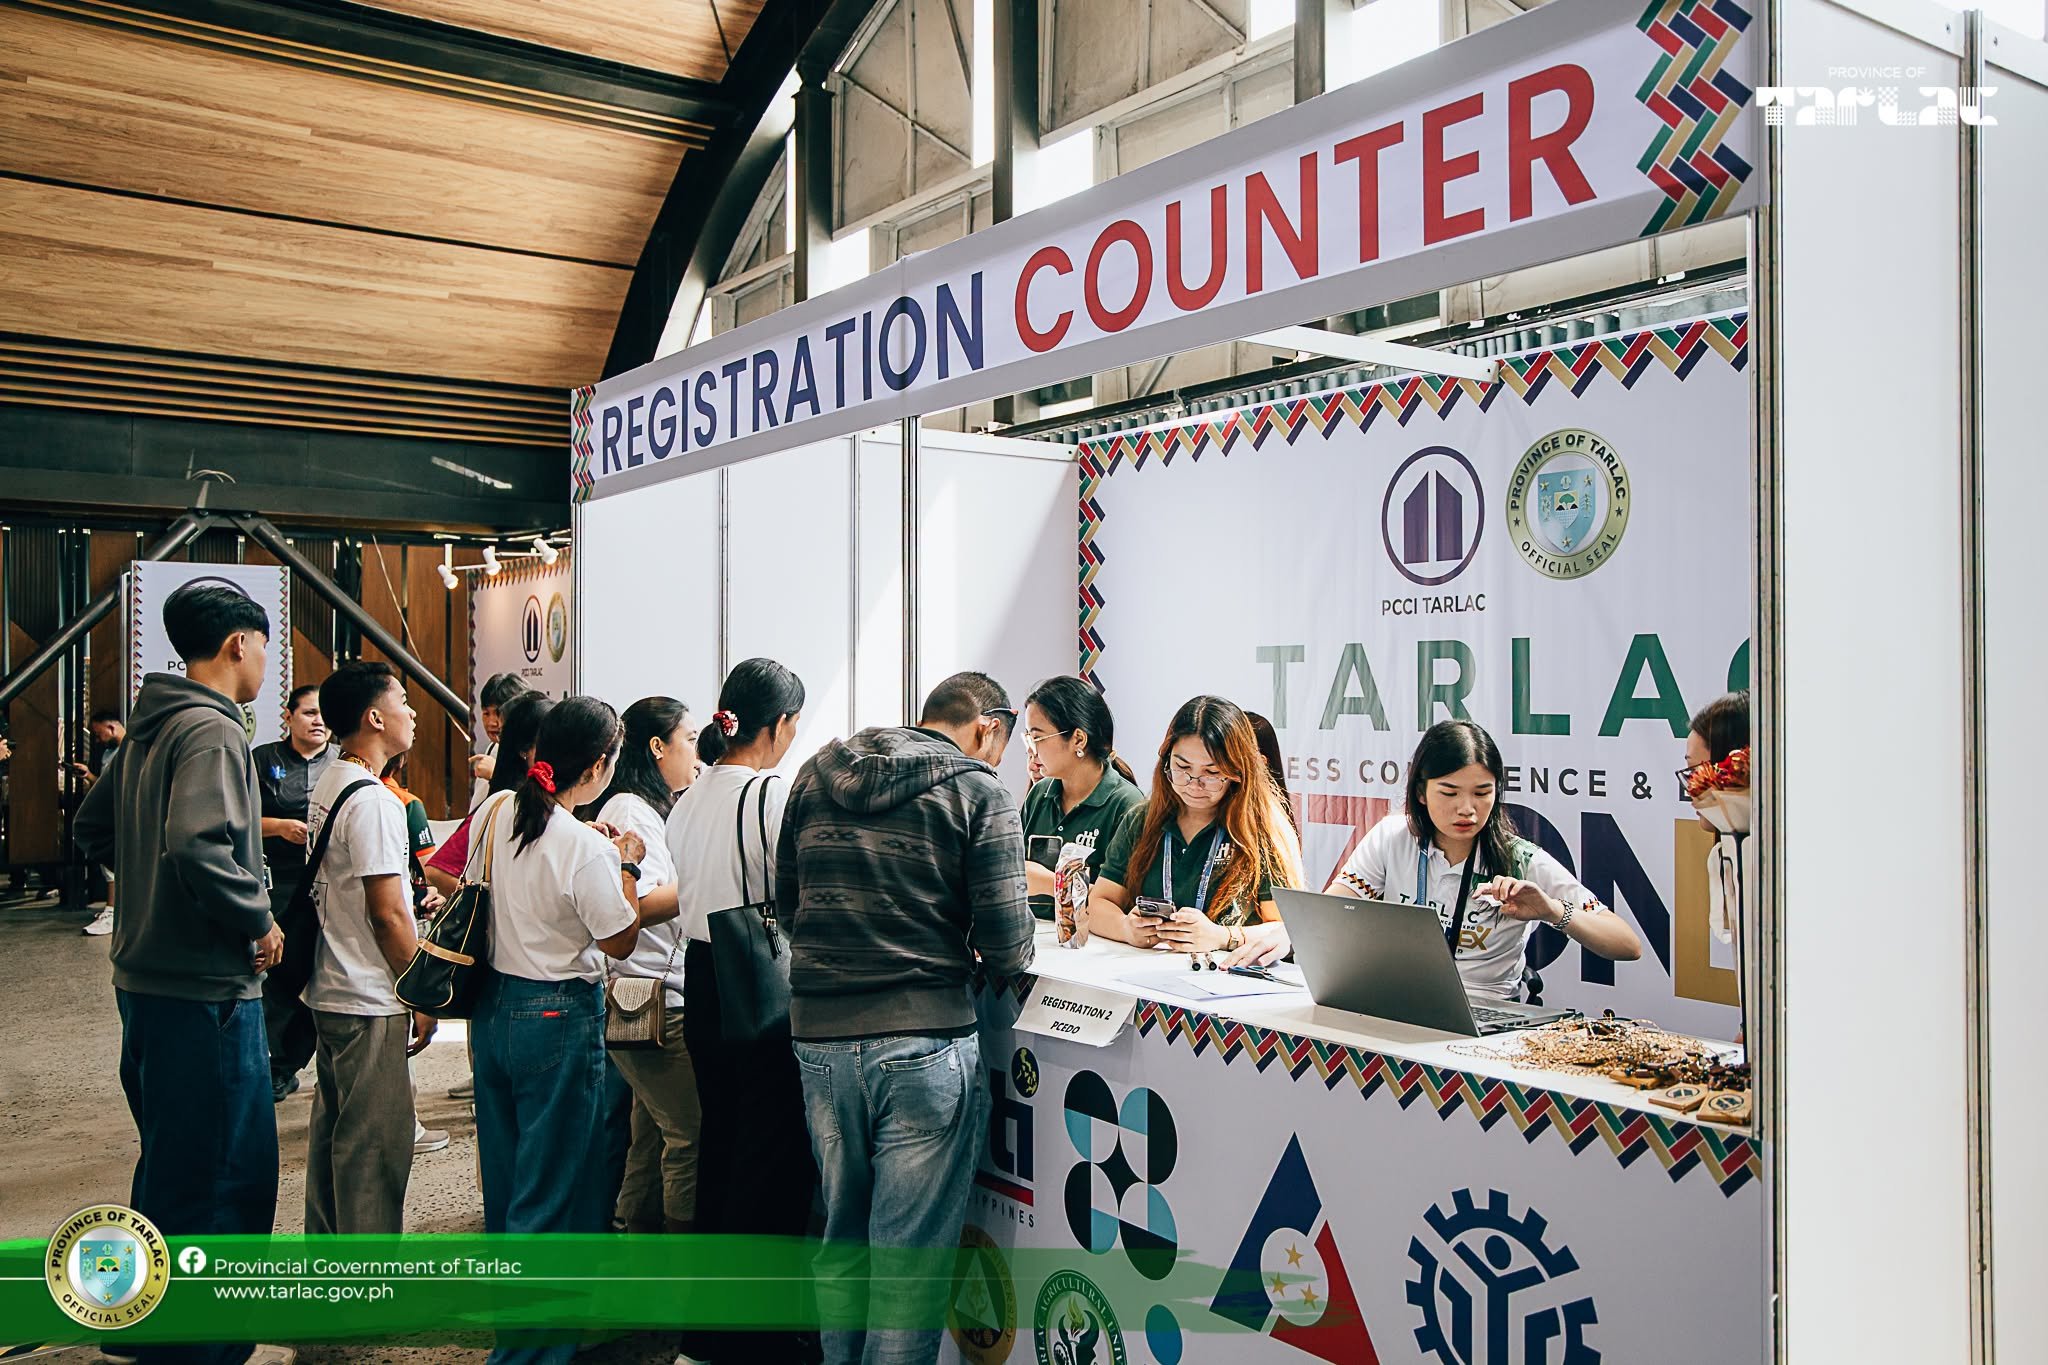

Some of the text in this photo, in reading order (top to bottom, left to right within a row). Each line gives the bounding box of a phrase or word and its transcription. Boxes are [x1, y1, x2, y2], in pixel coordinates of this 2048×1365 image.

[602, 63, 1598, 476] REGISTRATION COUNTER
[1511, 433, 1626, 510] PROVINCE OF TARLAC
[1521, 532, 1617, 574] OFFICIAL SEAL
[1382, 593, 1486, 616] PCCI TARLAC
[1256, 632, 1749, 739] TARLA
[1631, 771, 1653, 800] &
[1041, 995, 1113, 1021] REGISTRATION 2
[1050, 1020, 1081, 1034] PCEDO
